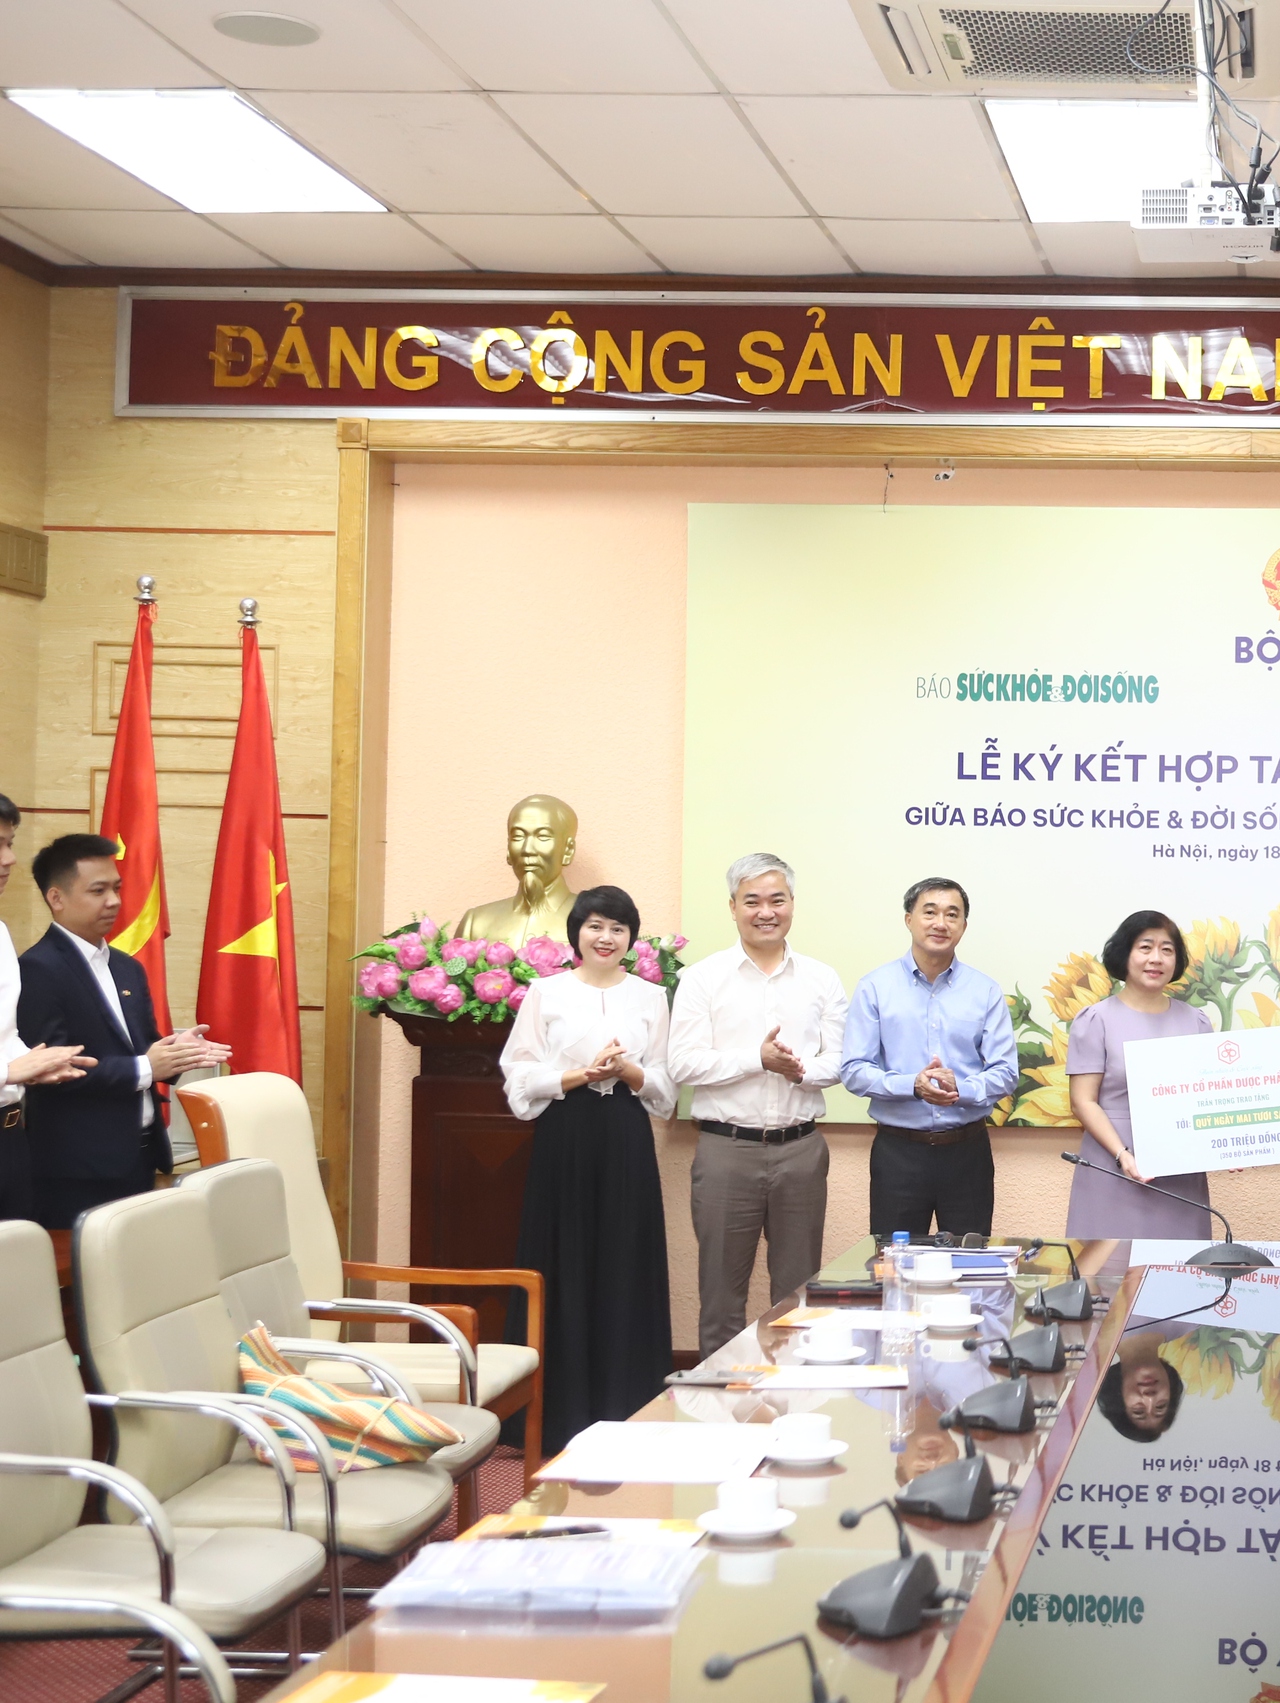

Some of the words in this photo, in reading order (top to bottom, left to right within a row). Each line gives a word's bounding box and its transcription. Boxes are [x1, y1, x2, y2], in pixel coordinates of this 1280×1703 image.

[208, 302, 439, 392] ĐẢNG
[472, 310, 707, 405] CỘNG
[735, 307, 903, 398] SẢN
[934, 317, 1122, 411] VIỆT
[917, 673, 951, 698] BÁO
[958, 738, 1000, 780] LỄ
[1014, 744, 1063, 781] KÝ
[1075, 741, 1147, 782] KẾT
[1159, 751, 1238, 791] HỢP
[905, 802, 965, 826] GIỮA
[974, 802, 1026, 827] BÁO
[1033, 803, 1084, 827] SỨC
[1092, 803, 1159, 828] KHỎE
[1167, 811, 1183, 829] &
[1191, 805, 1235, 829] ĐỜI
[1153, 844, 1174, 857] Hà
[1180, 844, 1212, 861] Nội,
[1218, 845, 1258, 861] ngày
[1264, 846, 1280, 858] 18
[1152, 1084, 1177, 1096] CÔNG
[1180, 1084, 1189, 1093] TY
[1214, 1113, 1234, 1125] NGÀY
[1236, 1114, 1251, 1124] MAI
[1211, 1139, 1227, 1148] 200
